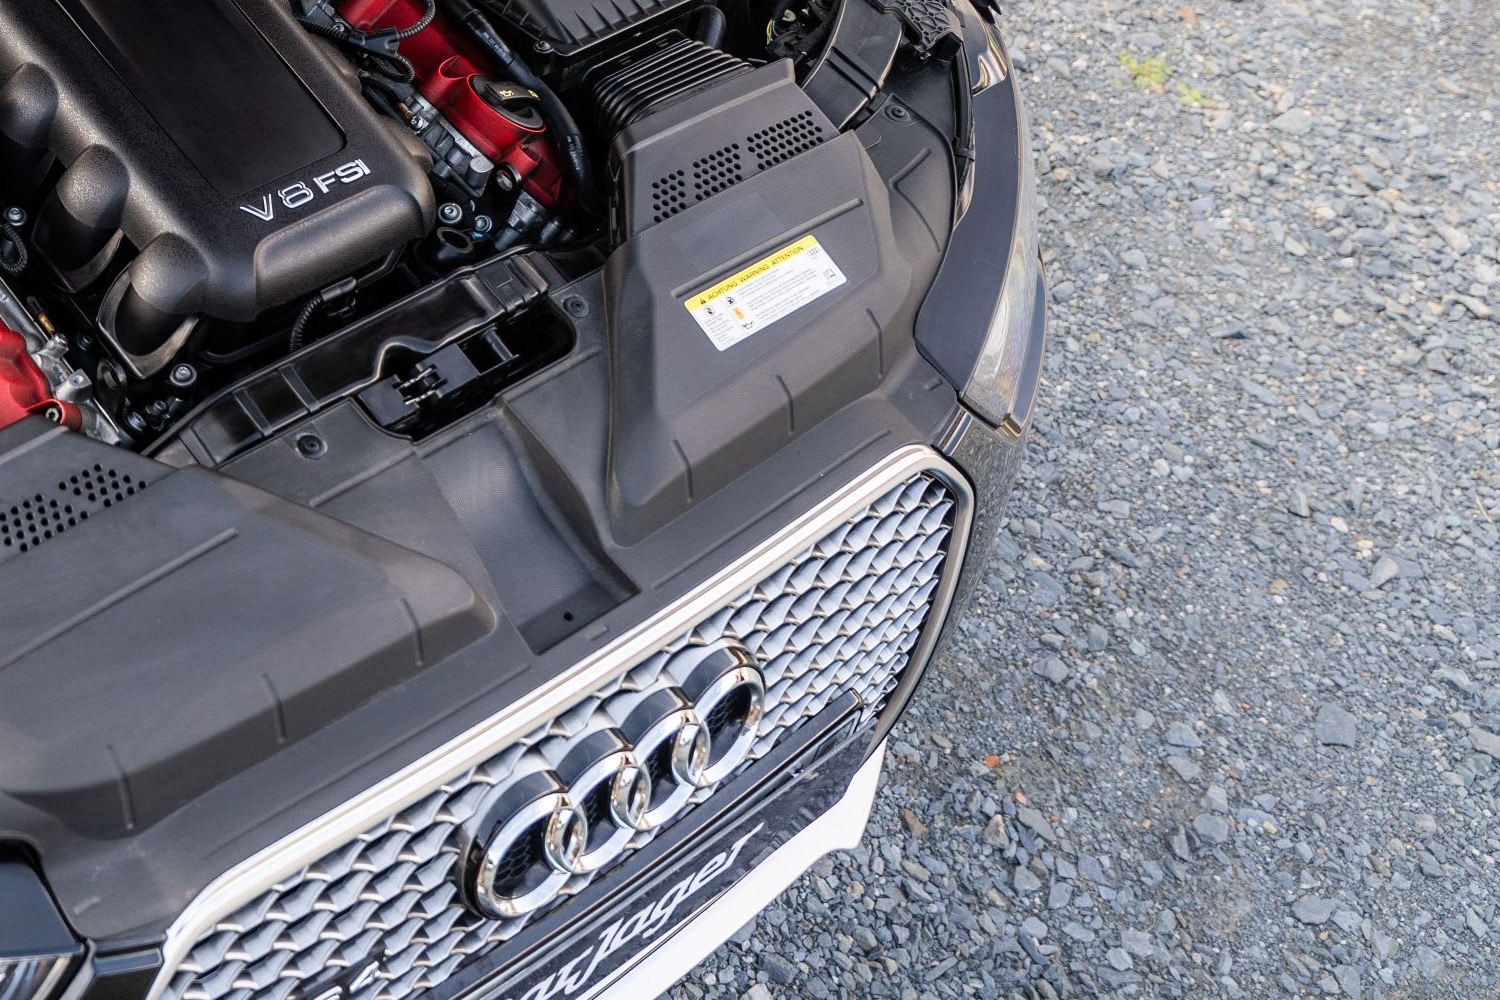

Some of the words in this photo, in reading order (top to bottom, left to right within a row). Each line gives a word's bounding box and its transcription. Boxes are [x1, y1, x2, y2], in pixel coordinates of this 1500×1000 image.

[312, 158, 371, 194] FSI
[707, 281, 738, 301] ACHTUNG
[739, 263, 770, 283] WARNING
[770, 245, 804, 266] ATTENTION
[505, 822, 765, 1000] arJager
